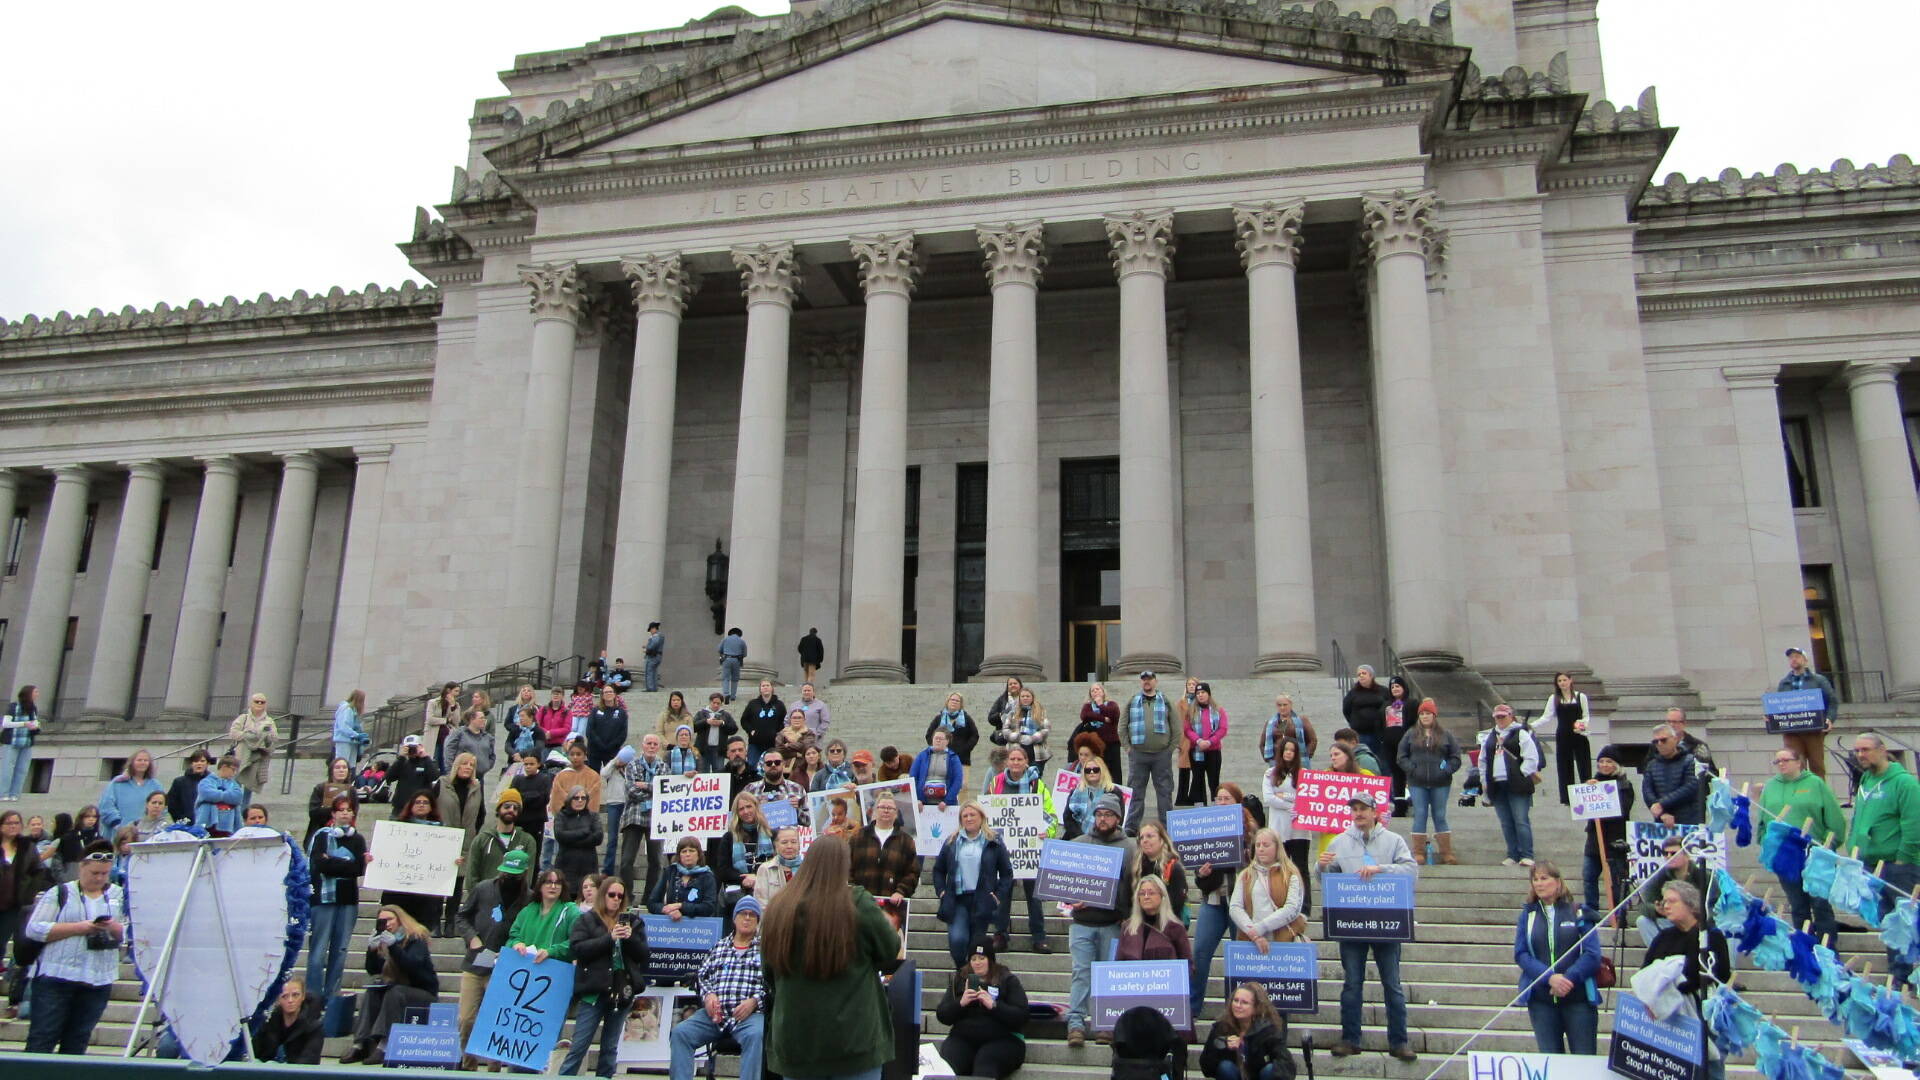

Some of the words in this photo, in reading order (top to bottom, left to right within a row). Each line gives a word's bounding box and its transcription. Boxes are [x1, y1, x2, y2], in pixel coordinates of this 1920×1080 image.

[712, 175, 953, 214] LEGISLATIVE
[1008, 152, 1201, 187] BUILDING
[1313, 773, 1360, 783] SHOULDN'T
[1362, 777, 1385, 786] TAKE
[660, 778, 692, 796] Every
[692, 777, 720, 792] Child
[1298, 783, 1319, 797] 25
[1575, 784, 1597, 794] KEEP
[1011, 796, 1040, 807] DEAD
[1583, 794, 1604, 802] KIDS
[660, 795, 723, 814] DESERVES
[1309, 802, 1324, 812] TO
[1327, 804, 1352, 815] CPS
[1589, 802, 1612, 810] SAFE
[1001, 807, 1015, 817] OR
[657, 822, 667, 834] to
[672, 820, 683, 832] be
[688, 814, 728, 831] SAFE!
[987, 817, 1020, 827] LMOST
[1173, 819, 1188, 827] Help
[1189, 817, 1215, 825] families
[1217, 814, 1236, 822] reach
[1297, 814, 1328, 826] SAVE
[1331, 818, 1338, 828] A
[1009, 827, 1038, 837] DEAD
[1191, 827, 1202, 835] full
[1203, 824, 1236, 836] potential!
[1018, 838, 1028, 848] IN
[1178, 844, 1203, 852] Change
[1215, 841, 1234, 850] Story,
[1009, 849, 1041, 860] MONTH
[1060, 850, 1081, 859] abuse,
[1093, 854, 1113, 864] drugs,
[1184, 853, 1199, 861] Stop
[1211, 850, 1229, 859] Cycle
[1012, 859, 1040, 870] SPAN
[1059, 859, 1085, 869] neglect,
[1048, 873, 1074, 883] Keeping
[1076, 877, 1089, 885] Kids
[1090, 879, 1107, 887] SAFE
[1049, 883, 1066, 891] starts
[1068, 885, 1083, 895] right
[1085, 887, 1102, 896] here!
[1338, 882, 1367, 891] Narcan
[1368, 883, 1376, 891] is
[1377, 883, 1395, 891] NOT
[1347, 895, 1372, 905] safety
[1373, 895, 1395, 905] plan!
[658, 925, 680, 933] abuse,
[692, 927, 713, 935] drugs,
[1337, 920, 1363, 929] Revise
[1365, 920, 1377, 929] HB
[1380, 921, 1400, 930] 1227
[658, 936, 683, 944] neglect,
[649, 951, 675, 961] eeping
[676, 952, 691, 960] Kids
[1246, 953, 1270, 961] abuse,
[1283, 954, 1306, 963] drugs,
[669, 962, 685, 971] right
[1247, 964, 1276, 973] neglect,
[1108, 970, 1140, 979] Narcan
[1142, 970, 1150, 978] is
[1151, 969, 1171, 978] NOT
[508, 968, 552, 1014] 92
[1118, 982, 1144, 992] safety
[1147, 982, 1169, 992] plan!
[1269, 982, 1285, 990] Kids
[1287, 982, 1305, 991] SAFE
[1268, 993, 1281, 1001] ght
[1283, 993, 1302, 1001] here!
[495, 1007, 512, 1027] IS
[513, 1012, 543, 1038] TOO
[1622, 1005, 1640, 1020] Help
[1641, 1011, 1671, 1031] failies
[1672, 1026, 1696, 1041] reach
[399, 1035, 418, 1043] Child
[418, 1036, 439, 1045] safety
[440, 1037, 454, 1045] isn't
[1621, 1020, 1639, 1033] their
[1640, 1025, 1653, 1038] full
[1654, 1034, 1693, 1056] potential!
[487, 1031, 539, 1062] MANY
[403, 1048, 431, 1057] partisan
[432, 1048, 452, 1057] issue.
[1621, 1040, 1650, 1058] Change
[1651, 1053, 1664, 1064] the
[1665, 1058, 1686, 1076] Story,
[1473, 1055, 1549, 1080] HOW
[1626, 1055, 1643, 1070] Stop
[1644, 1064, 1656, 1075] the
[1658, 1070, 1679, 1080] Cycl
